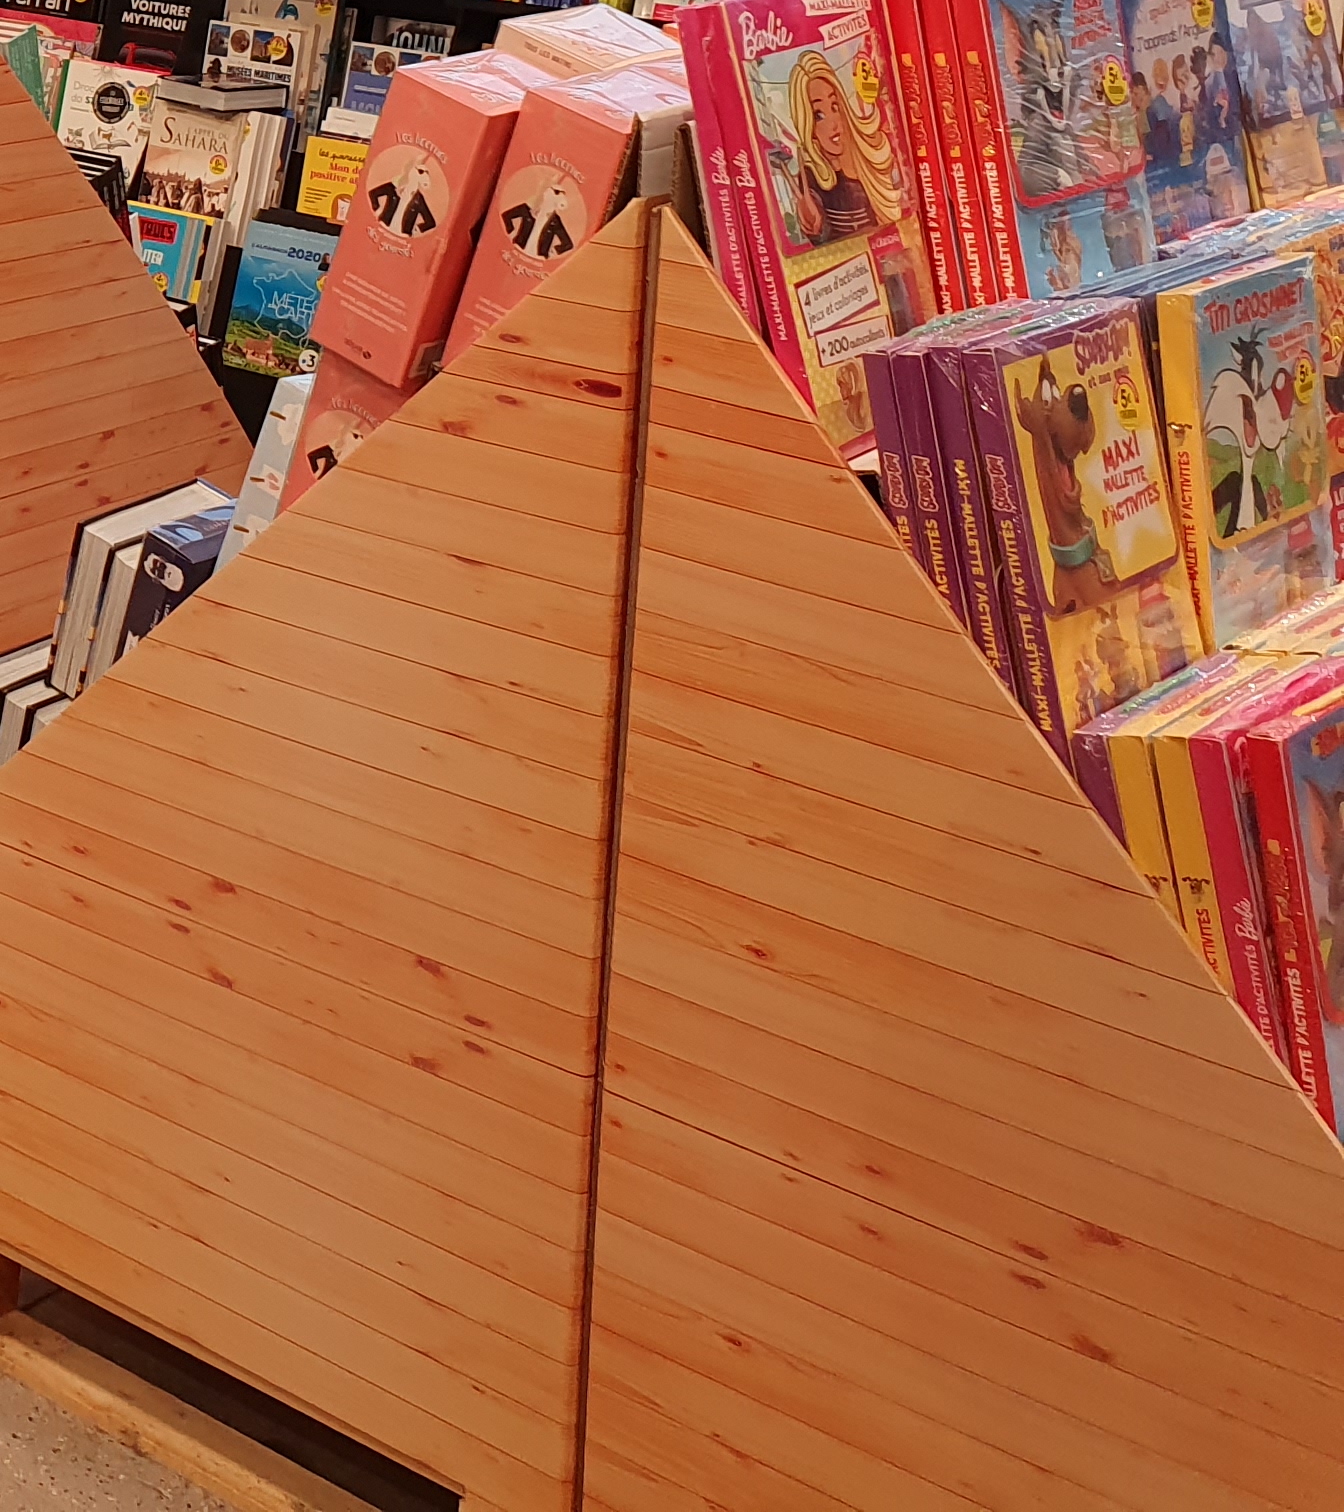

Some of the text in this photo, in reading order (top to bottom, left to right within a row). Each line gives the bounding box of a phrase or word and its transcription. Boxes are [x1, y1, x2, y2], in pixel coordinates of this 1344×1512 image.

[738, 10, 795, 61] Barbie
[159, 116, 229, 155] SAHARA
[287, 246, 322, 263] 2020
[1101, 435, 1141, 471] MAXI
[1102, 467, 1147, 495] MALLETTE
[1015, 615, 1053, 731] MAXI-MALLETTE
